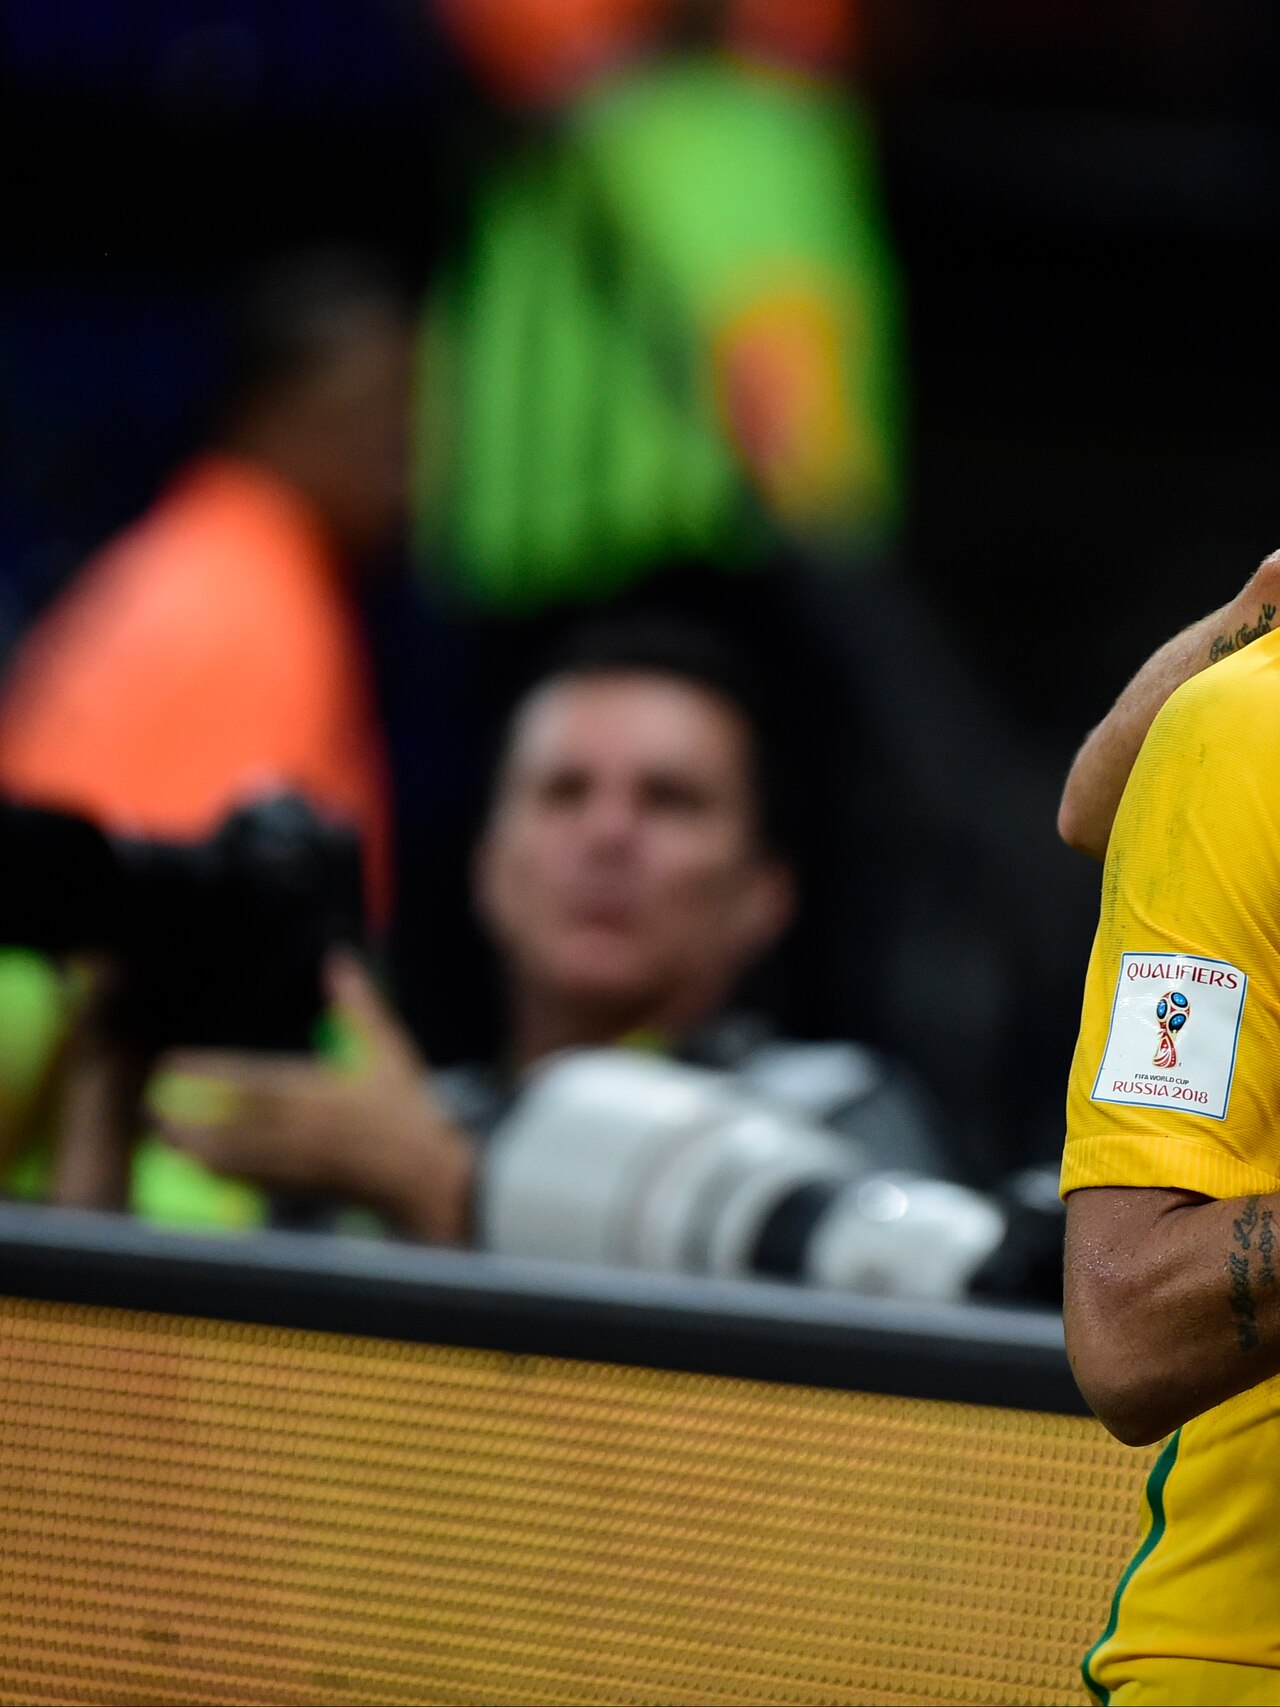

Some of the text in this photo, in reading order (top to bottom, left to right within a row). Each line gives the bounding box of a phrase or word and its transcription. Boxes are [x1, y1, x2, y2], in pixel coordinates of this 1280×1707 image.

[1126, 962, 1238, 990] QUALIFIERS
[1112, 1080, 1208, 1104] RUSSIA 2018
[1149, 1074, 1175, 1083] WORLD
[1175, 1078, 1190, 1086] CUP
